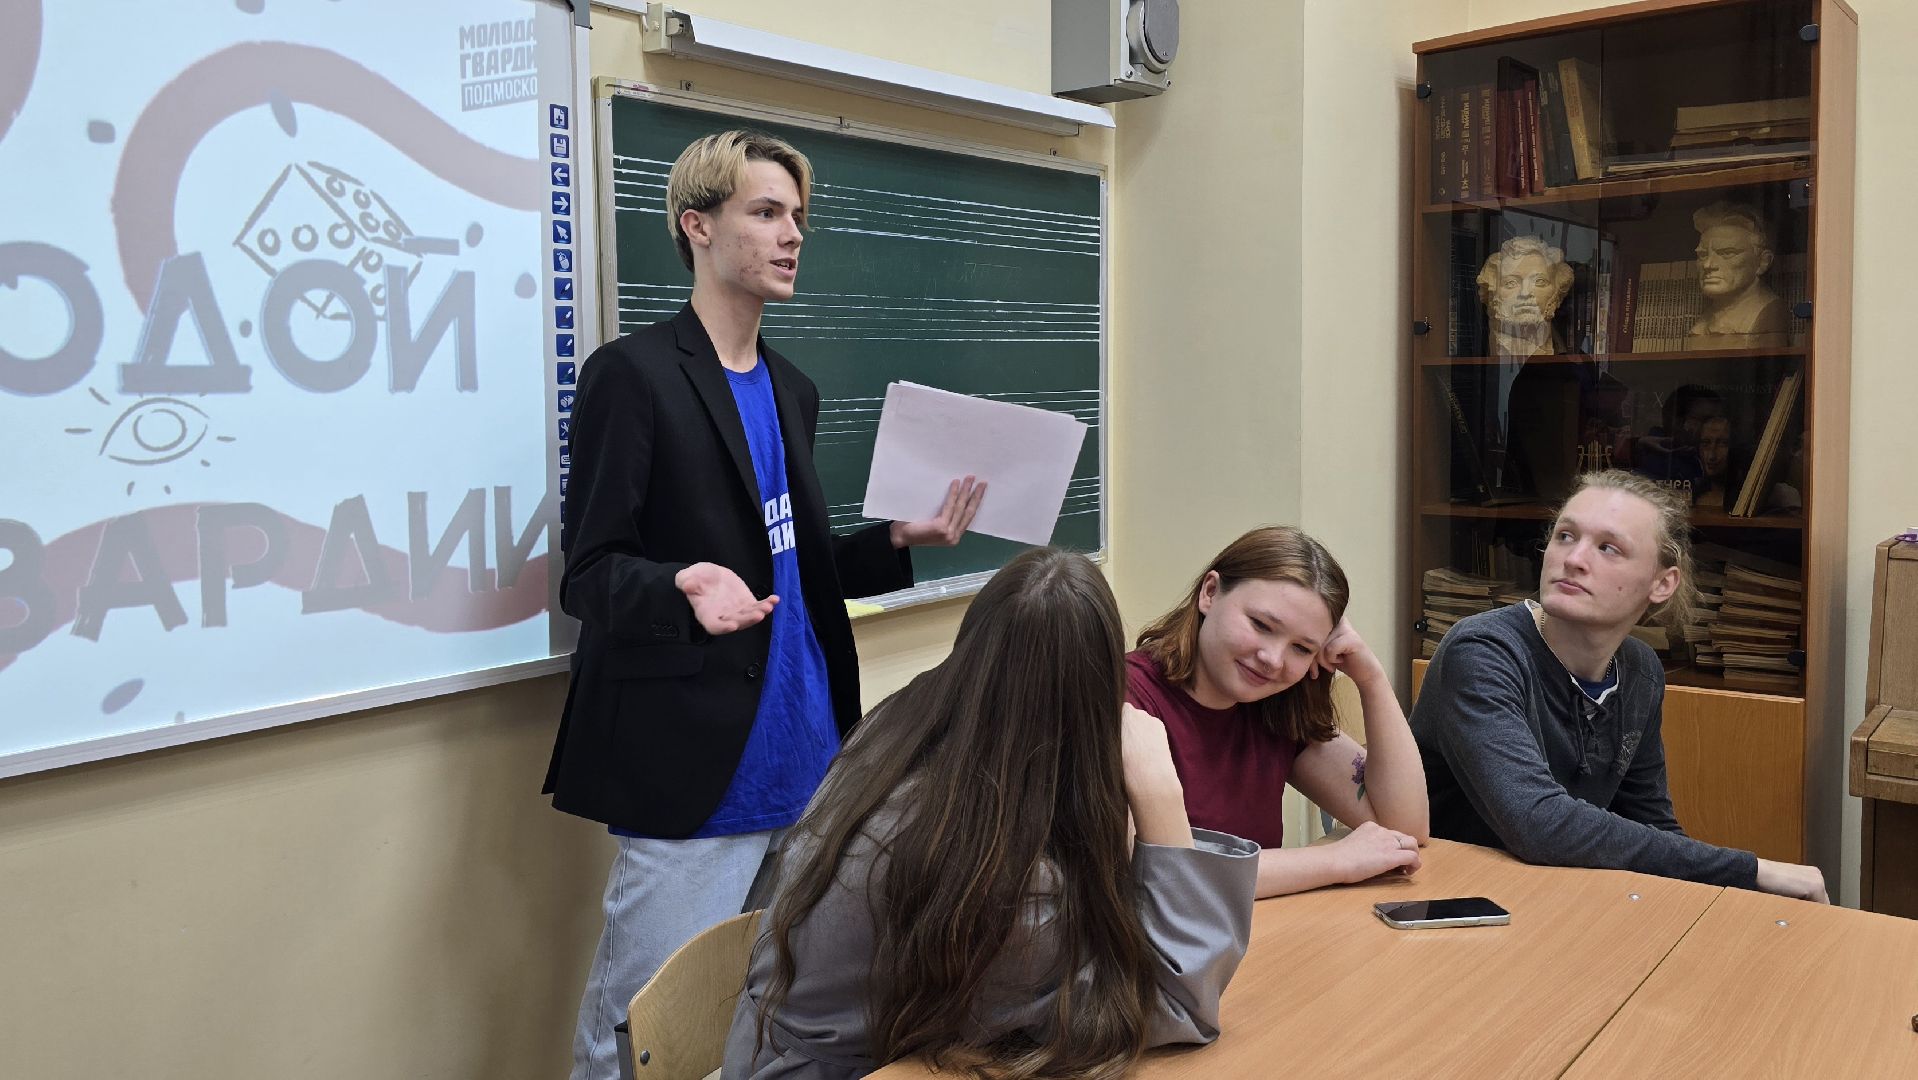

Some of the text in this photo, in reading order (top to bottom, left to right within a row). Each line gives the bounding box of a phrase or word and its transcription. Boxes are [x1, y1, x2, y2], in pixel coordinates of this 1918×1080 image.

[459, 19, 536, 50] МОЛОДА
[460, 44, 538, 79] ГВАРДИ
[465, 77, 538, 107] ПОДМОСКО
[765, 492, 792, 527] ДА
[768, 521, 796, 555] ДИ
